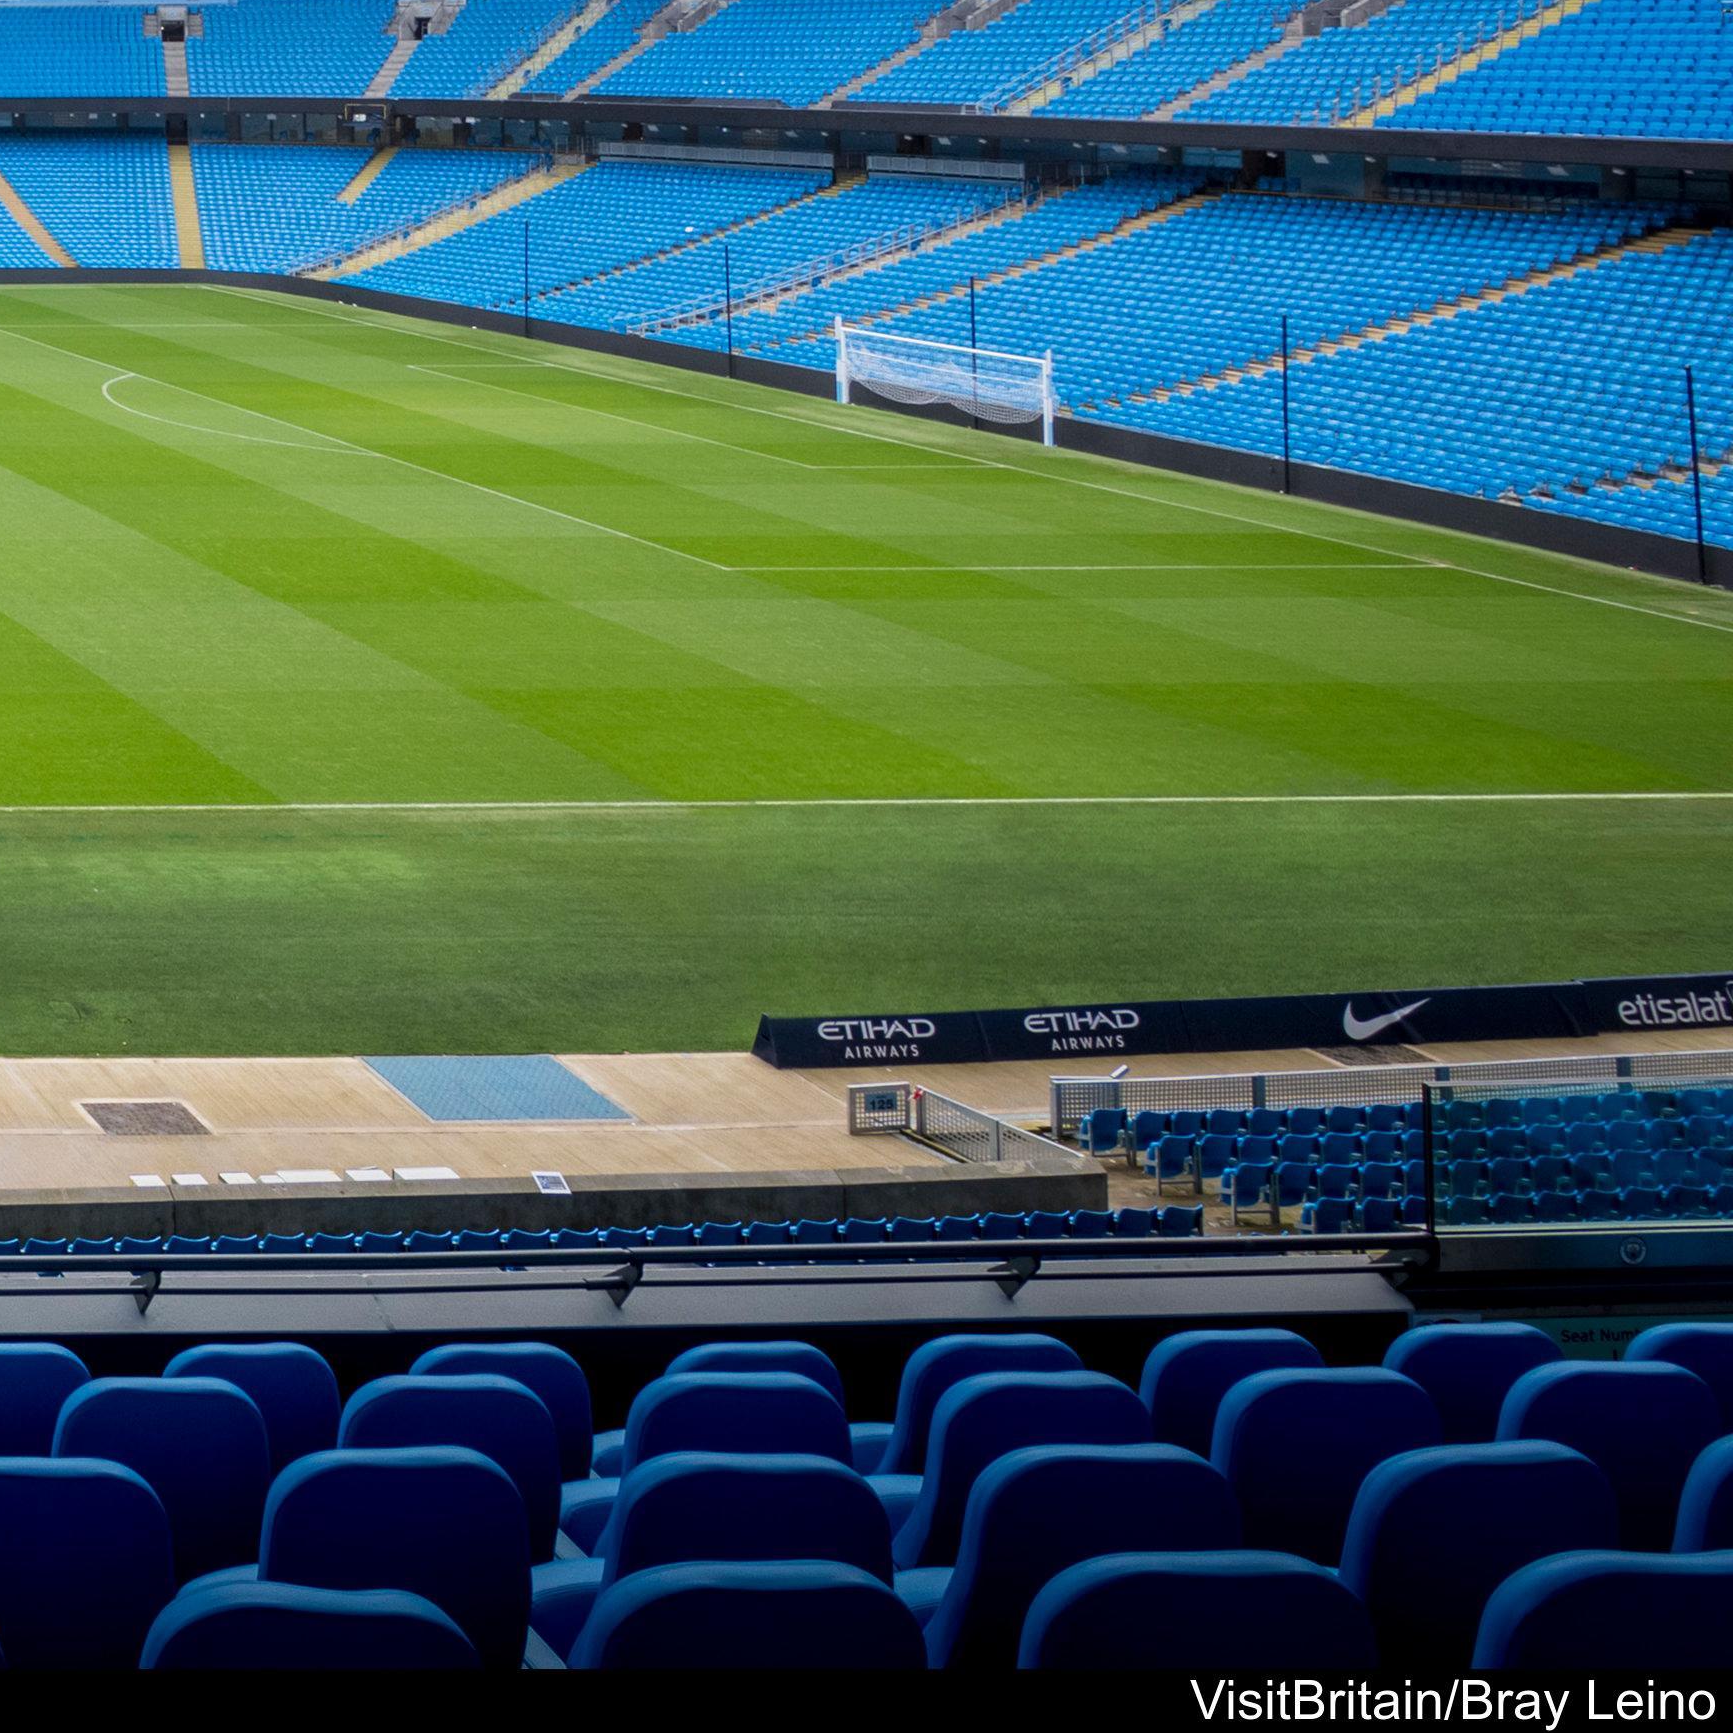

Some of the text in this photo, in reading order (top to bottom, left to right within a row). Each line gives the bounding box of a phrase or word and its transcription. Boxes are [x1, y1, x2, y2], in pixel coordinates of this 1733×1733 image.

[1618, 991, 1733, 1025] etisalat
[817, 1019, 936, 1041] ETIHAD
[1024, 1010, 1139, 1033] ETIHAD
[1051, 1034, 1125, 1051] AIRWAYS
[845, 1044, 920, 1059] AIRWAYS
[870, 1098, 893, 1110] 125
[1561, 1329, 1595, 1343] Seat
